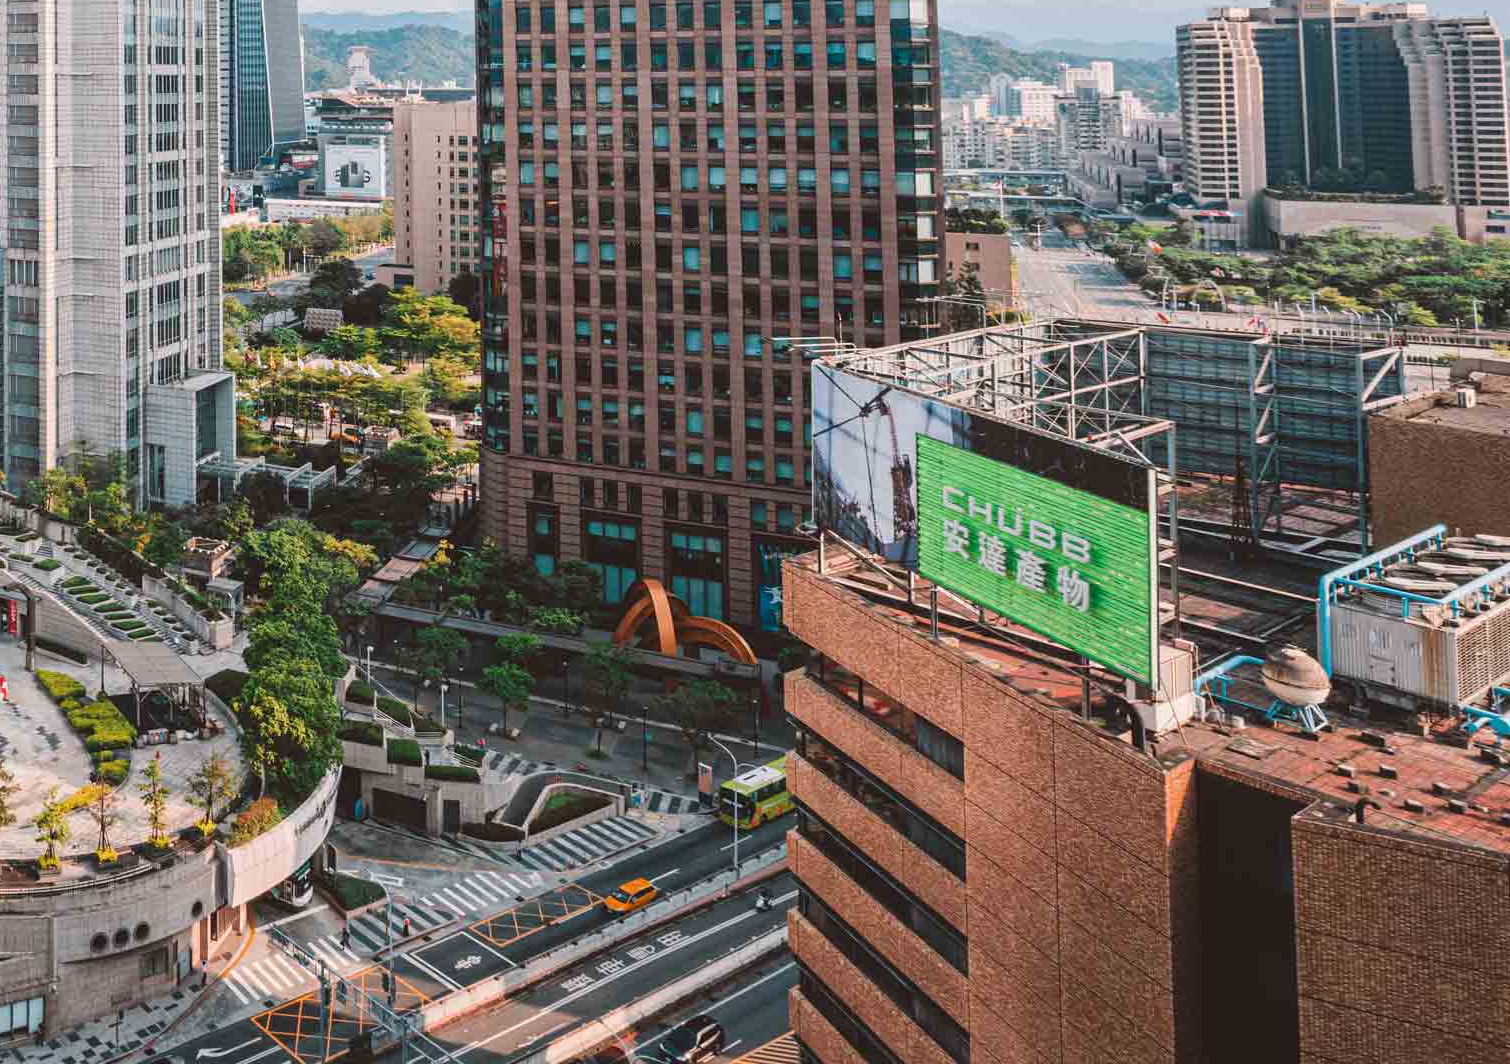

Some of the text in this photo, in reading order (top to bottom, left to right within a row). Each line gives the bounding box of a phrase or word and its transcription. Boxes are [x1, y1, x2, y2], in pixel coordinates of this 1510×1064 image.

[943, 487, 1091, 563] CHUBB
[944, 520, 1091, 614] 安達產物
